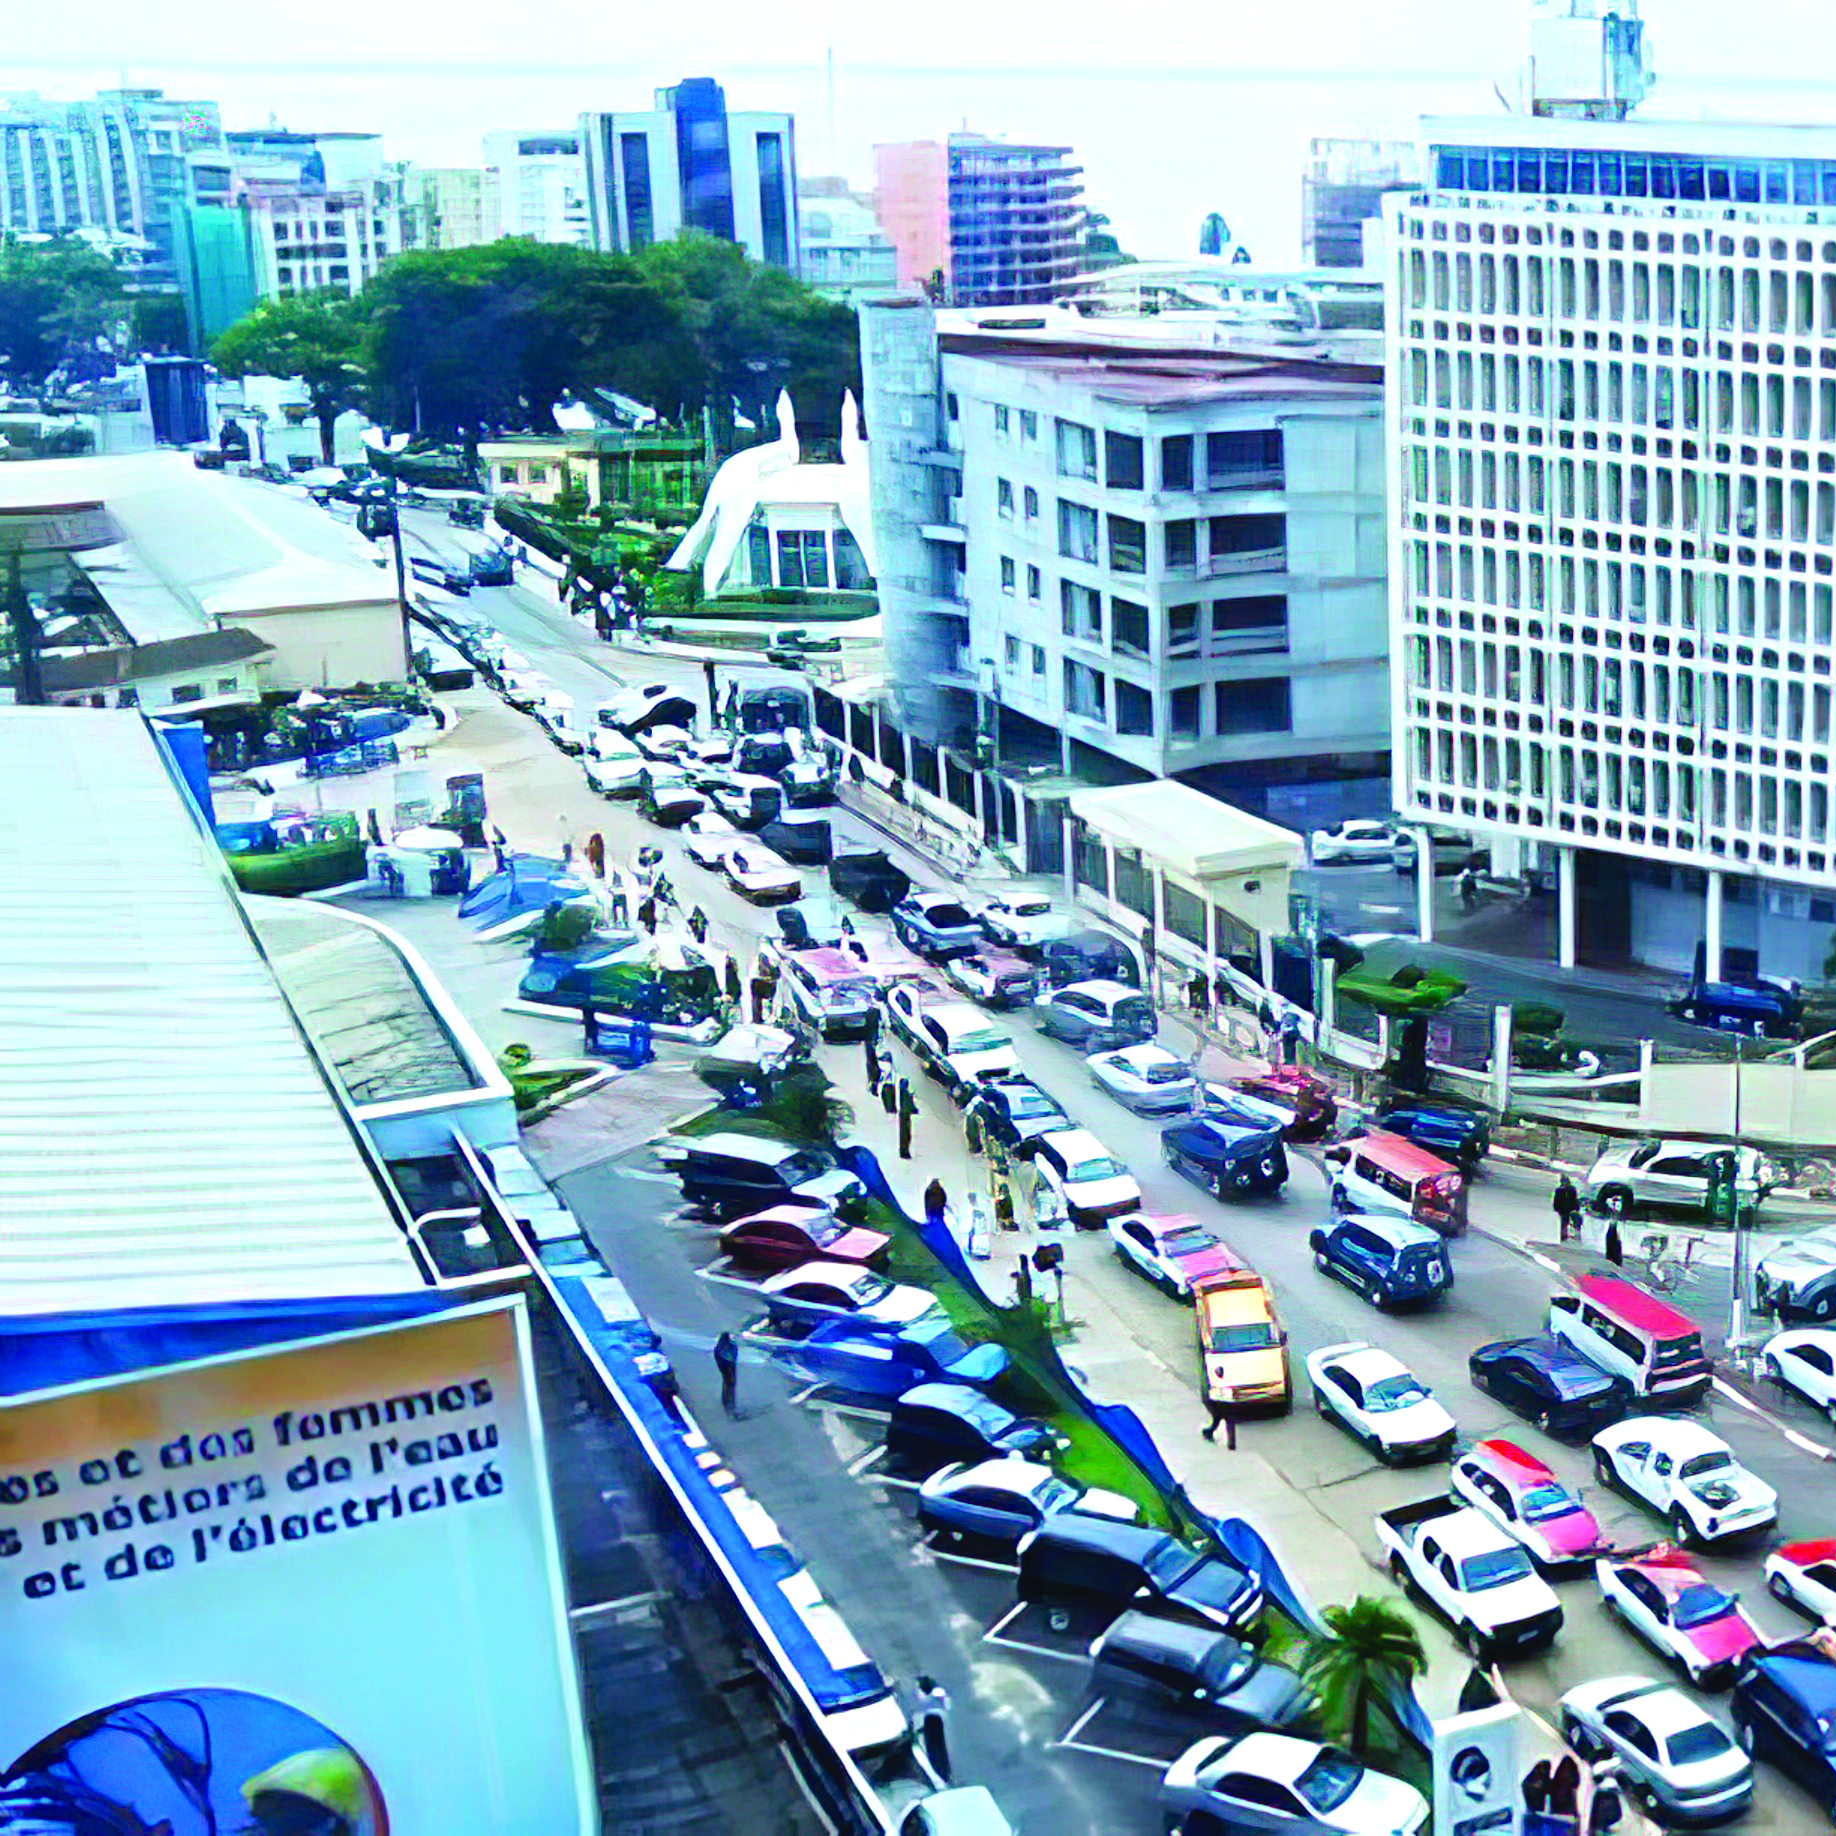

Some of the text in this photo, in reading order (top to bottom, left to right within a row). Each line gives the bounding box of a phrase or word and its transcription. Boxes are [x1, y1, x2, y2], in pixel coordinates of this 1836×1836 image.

[272, 1377, 493, 1447] femmes
[23, 1462, 503, 1599] et de l'électricité
[42, 1474, 267, 1546] métiers
[286, 1455, 352, 1492] de
[369, 1423, 499, 1474] l'eau
